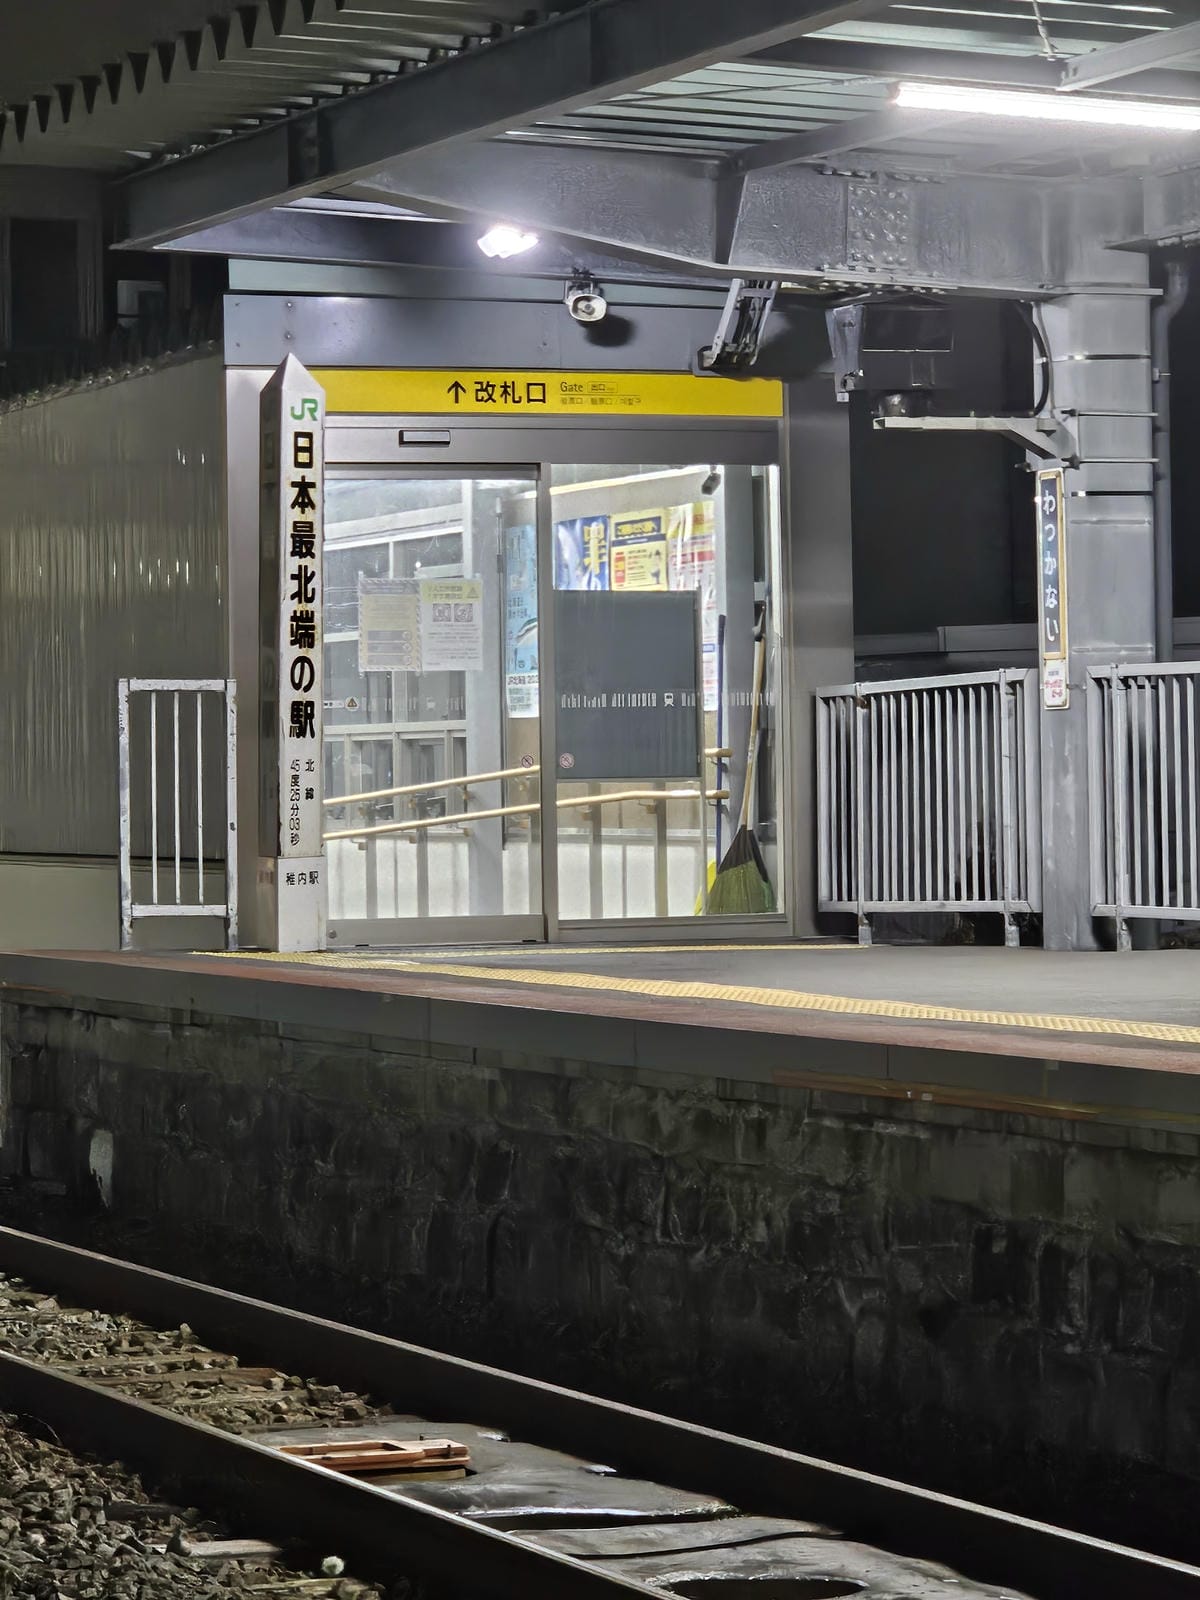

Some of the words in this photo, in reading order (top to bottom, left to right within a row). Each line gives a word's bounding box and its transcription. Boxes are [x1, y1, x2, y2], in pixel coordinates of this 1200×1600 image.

[474, 381, 547, 404] 改札口
[560, 382, 584, 393] Gate
[290, 398, 319, 421] JR
[289, 431, 317, 739] 日本最北端の駅
[285, 870, 320, 886] 稚内駅
